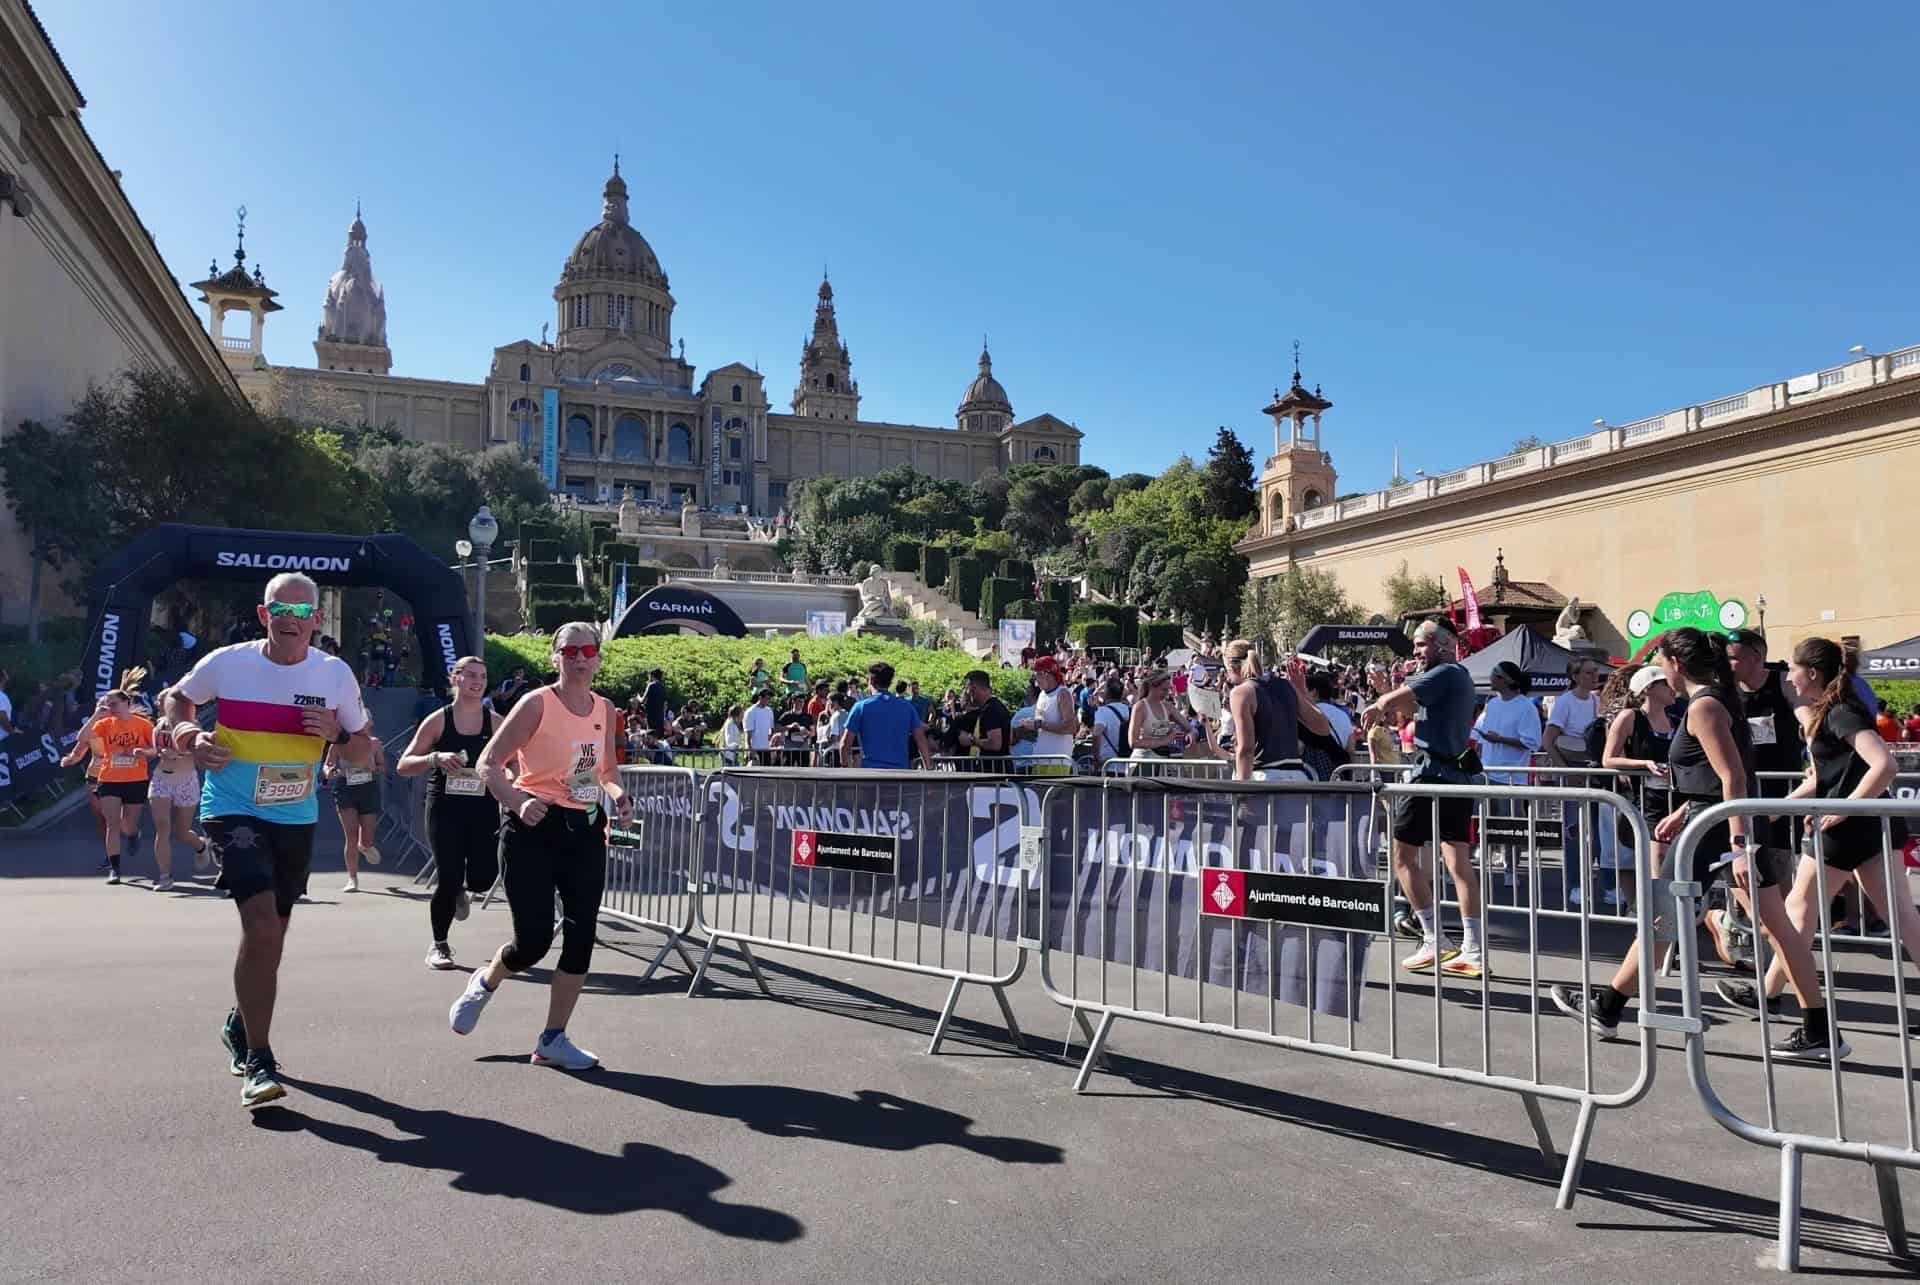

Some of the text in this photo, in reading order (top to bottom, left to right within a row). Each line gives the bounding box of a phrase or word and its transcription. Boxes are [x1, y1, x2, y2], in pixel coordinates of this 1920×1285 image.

[216, 552, 351, 571] SALOMON
[649, 601, 713, 614] GARMIN
[1338, 631, 1388, 639] SALOMON
[95, 613, 120, 699] LOMON
[1869, 658, 1920, 670] SALO
[581, 744, 596, 756] WE
[577, 758, 597, 769] RUN
[269, 783, 304, 797] 3990
[816, 844, 893, 860] Ajuntament de Barcelona
[1249, 889, 1380, 913] Ajuntament de Barcelona
